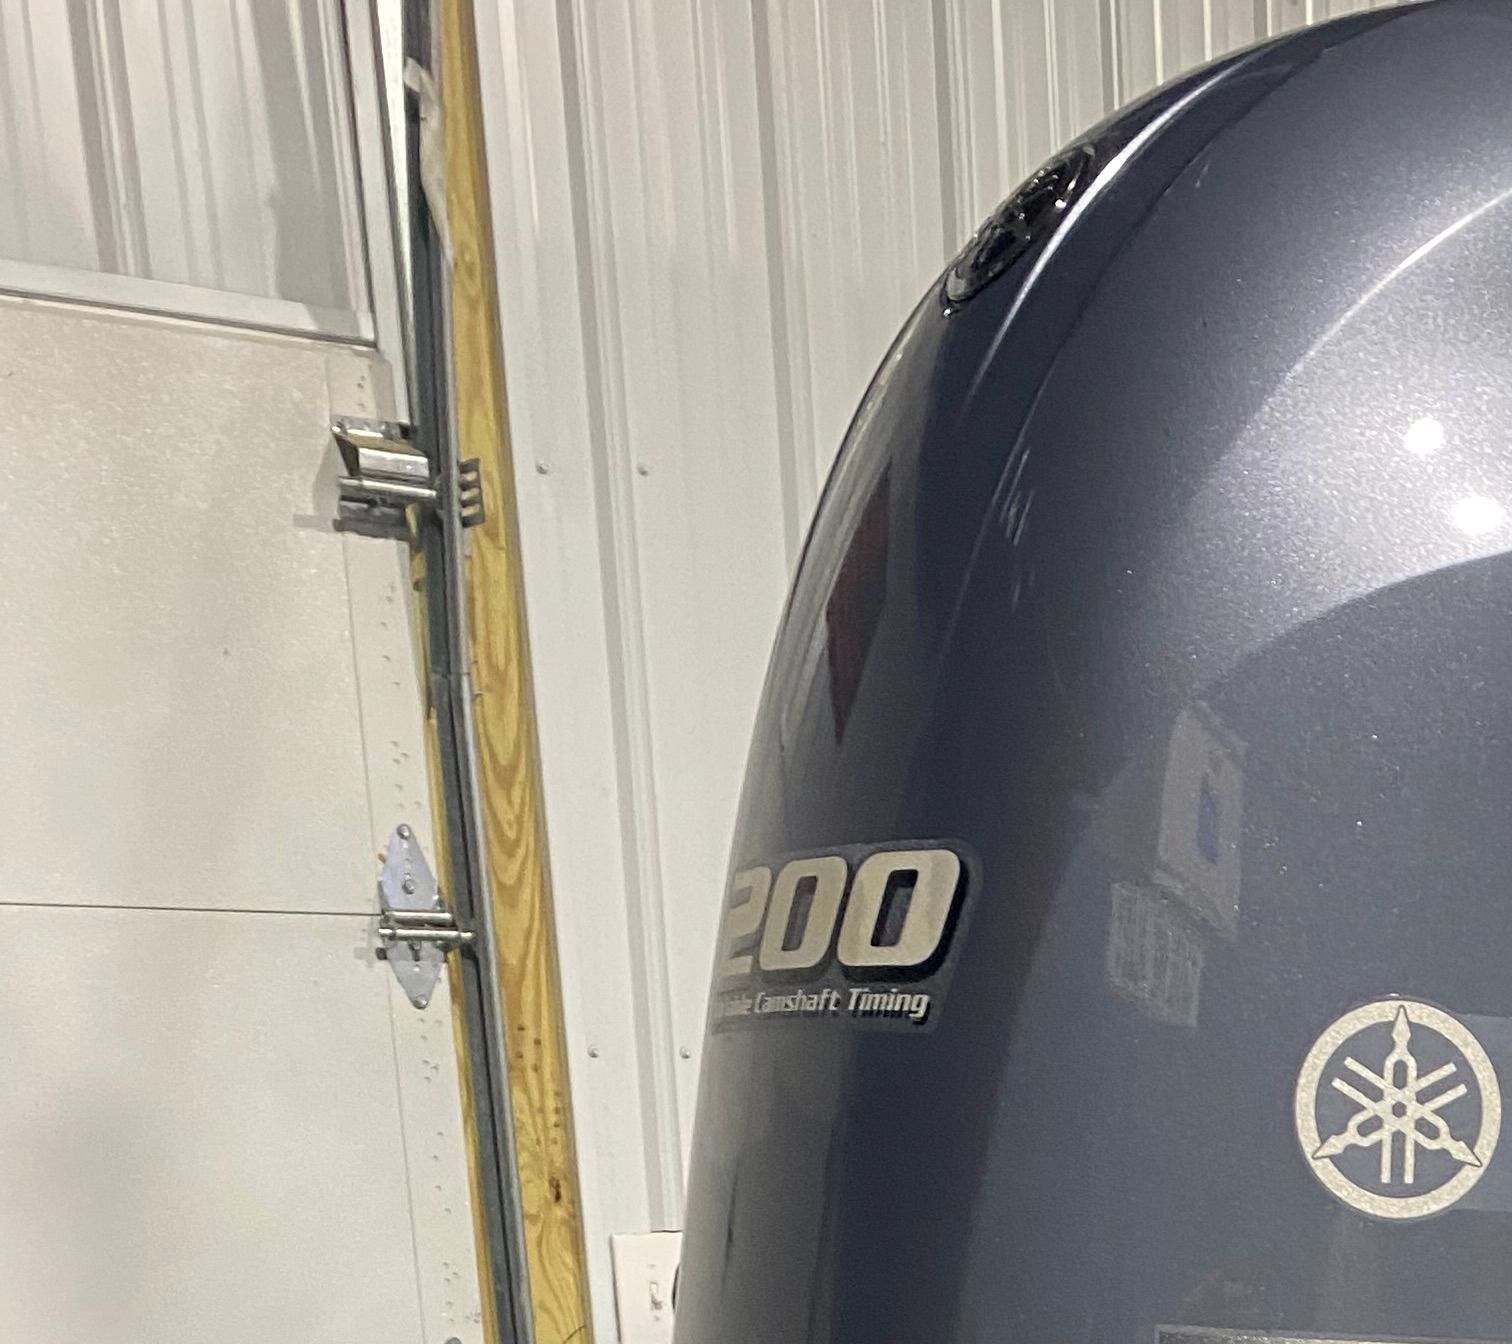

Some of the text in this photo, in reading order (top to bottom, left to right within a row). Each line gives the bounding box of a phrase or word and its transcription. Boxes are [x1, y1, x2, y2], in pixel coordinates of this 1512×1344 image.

[717, 849, 962, 979] 200
[754, 988, 839, 1013] Camshaft
[848, 987, 930, 1018] Timing
